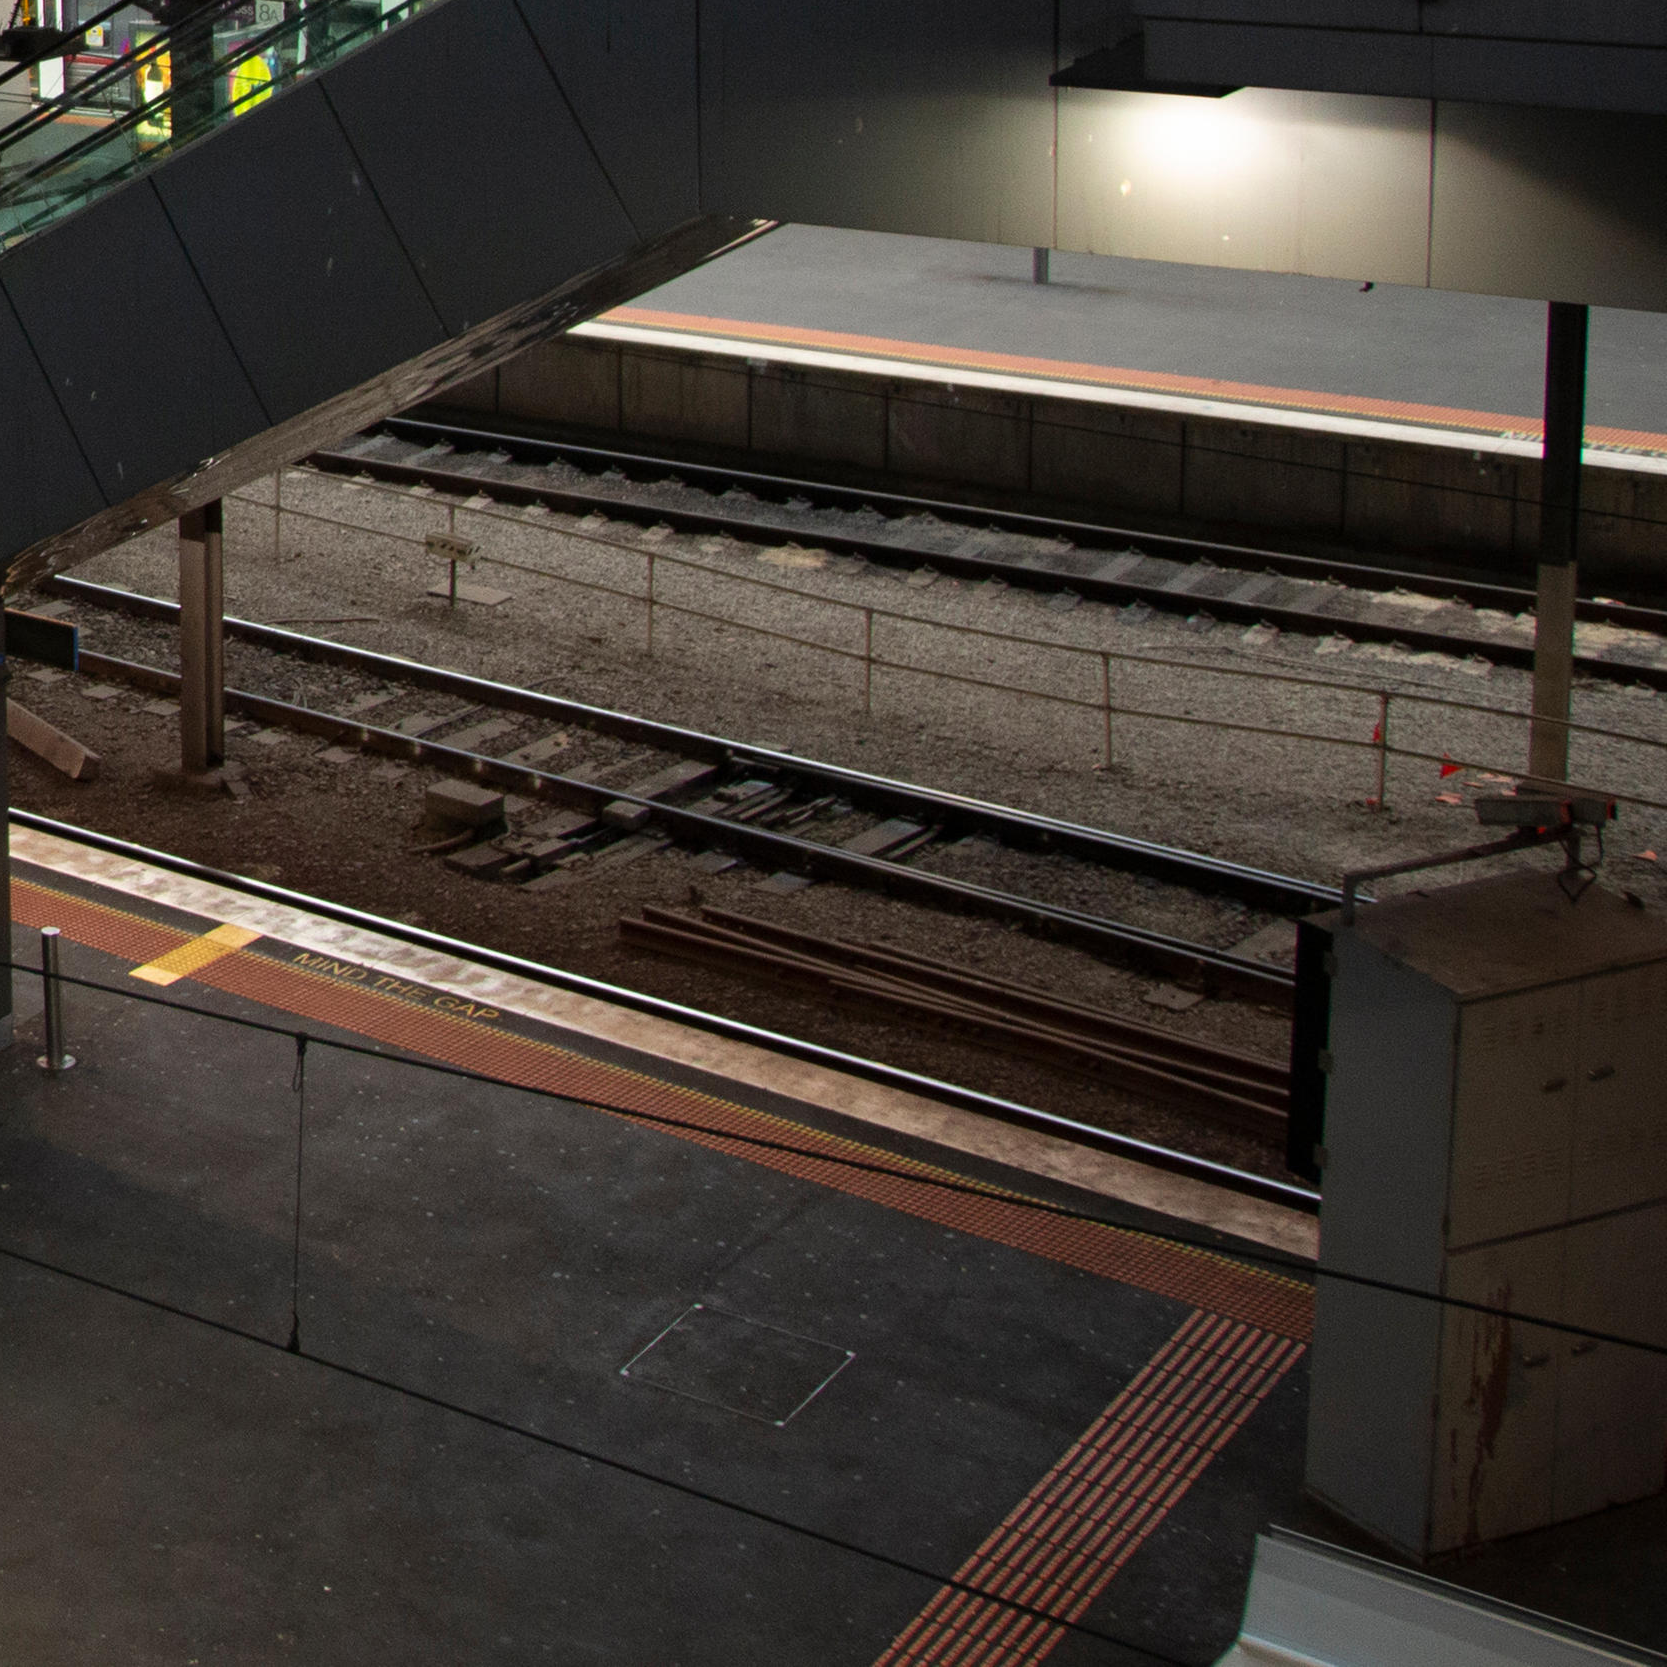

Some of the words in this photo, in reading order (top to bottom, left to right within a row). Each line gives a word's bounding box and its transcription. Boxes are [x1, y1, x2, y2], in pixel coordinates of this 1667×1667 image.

[260, 4, 279, 22] 8A
[293, 952, 367, 981] MIND
[374, 974, 433, 1000] THE
[433, 996, 500, 1020] GAP
